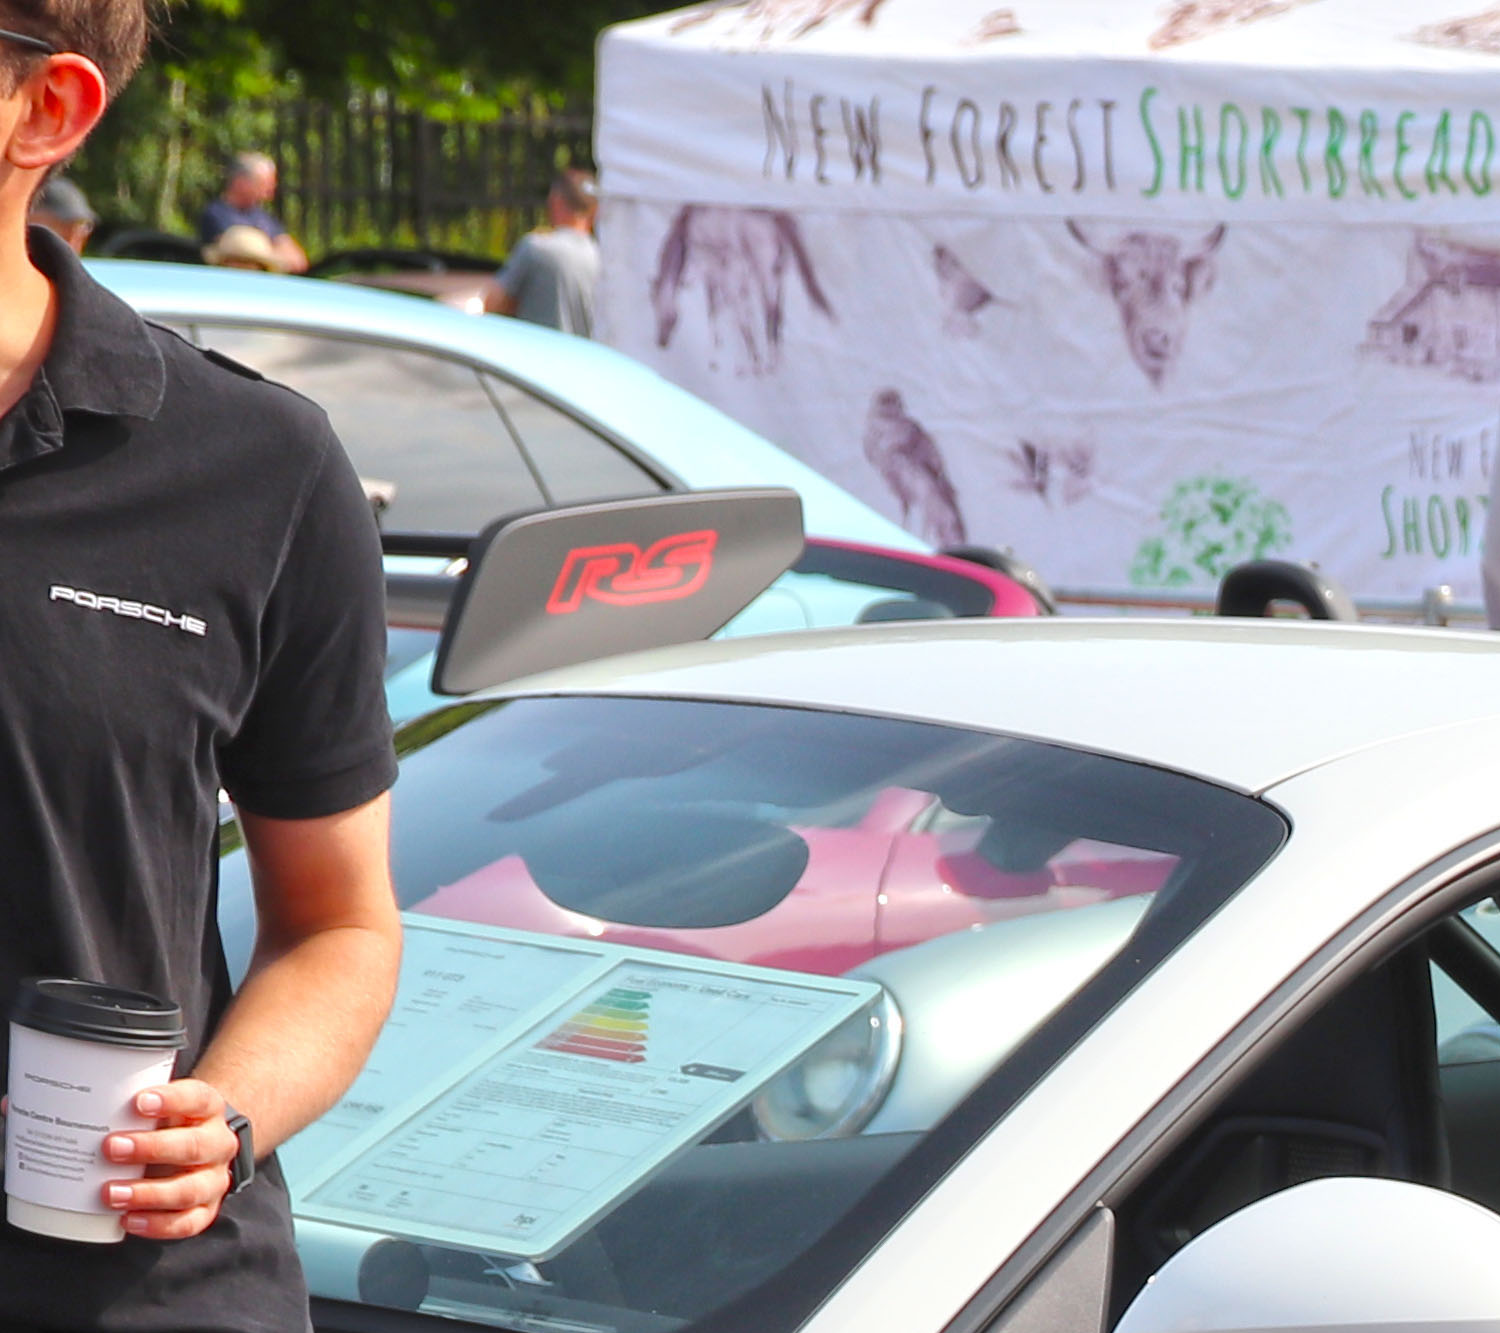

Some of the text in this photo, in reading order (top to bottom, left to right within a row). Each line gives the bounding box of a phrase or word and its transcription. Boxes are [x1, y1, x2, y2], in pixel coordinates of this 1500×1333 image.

[762, 78, 1494, 200] NEW FOREST SHORTBREAD
[49, 584, 208, 637] PORSCHE
[545, 529, 718, 614] RS
